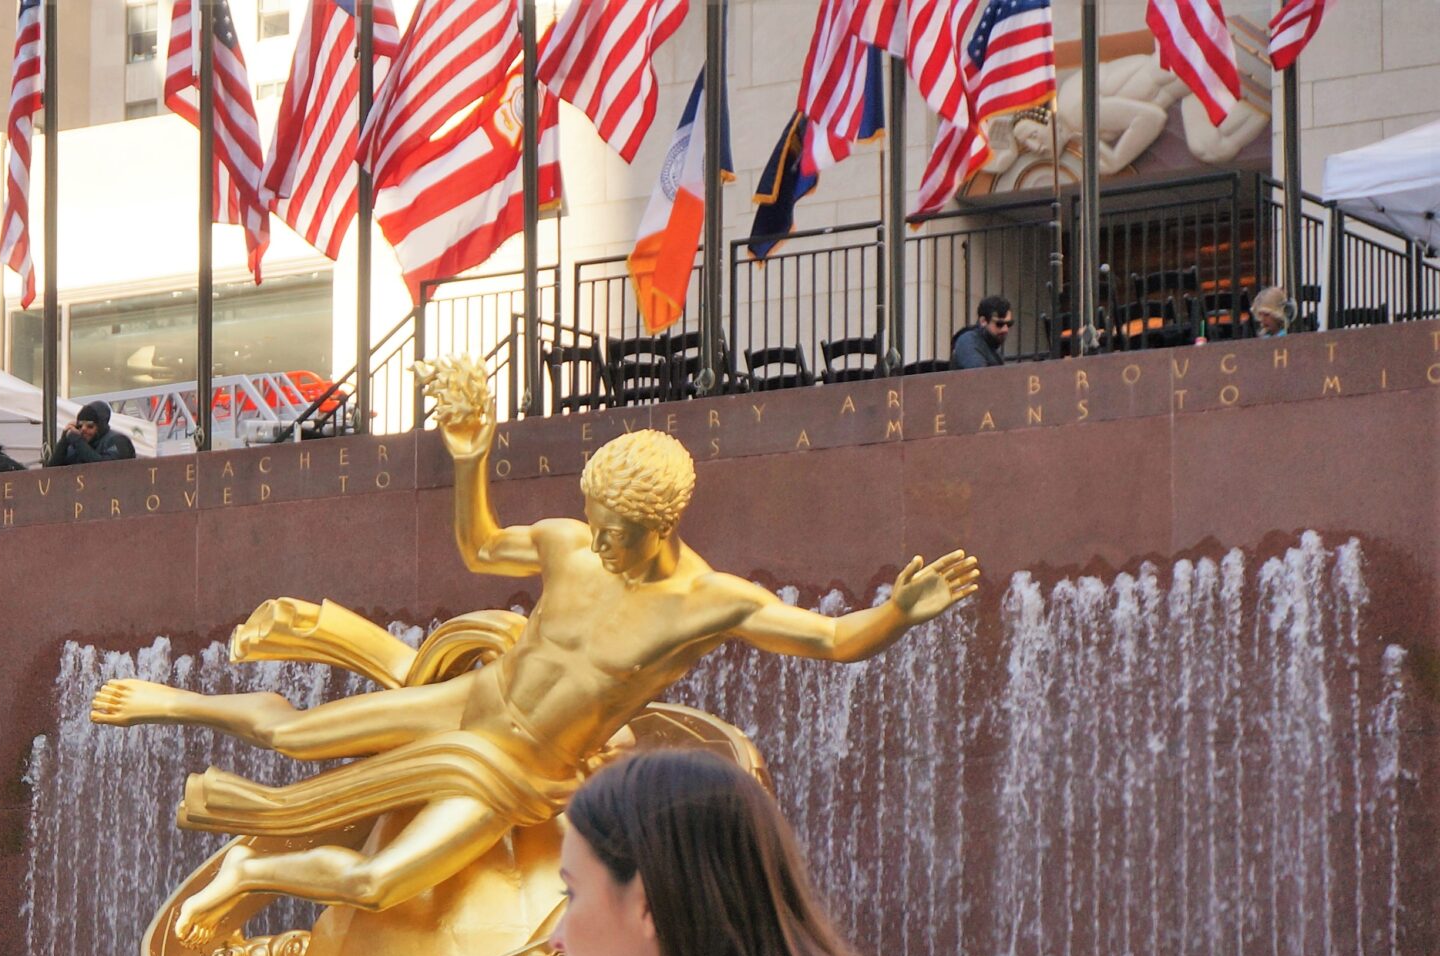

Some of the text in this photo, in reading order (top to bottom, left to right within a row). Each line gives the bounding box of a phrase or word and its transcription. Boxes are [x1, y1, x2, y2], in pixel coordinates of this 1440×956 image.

[74, 484, 271, 519] PROVED
[339, 471, 391, 493] TO
[796, 429, 810, 447] A
[886, 399, 1089, 440] MEANS
[1175, 385, 1239, 409] TO
[148, 444, 388, 485] TEACHER
[498, 432, 509, 449] N
[582, 404, 766, 441] EVERY
[841, 384, 946, 414] ART
[1027, 342, 1337, 395] BROUGHT
